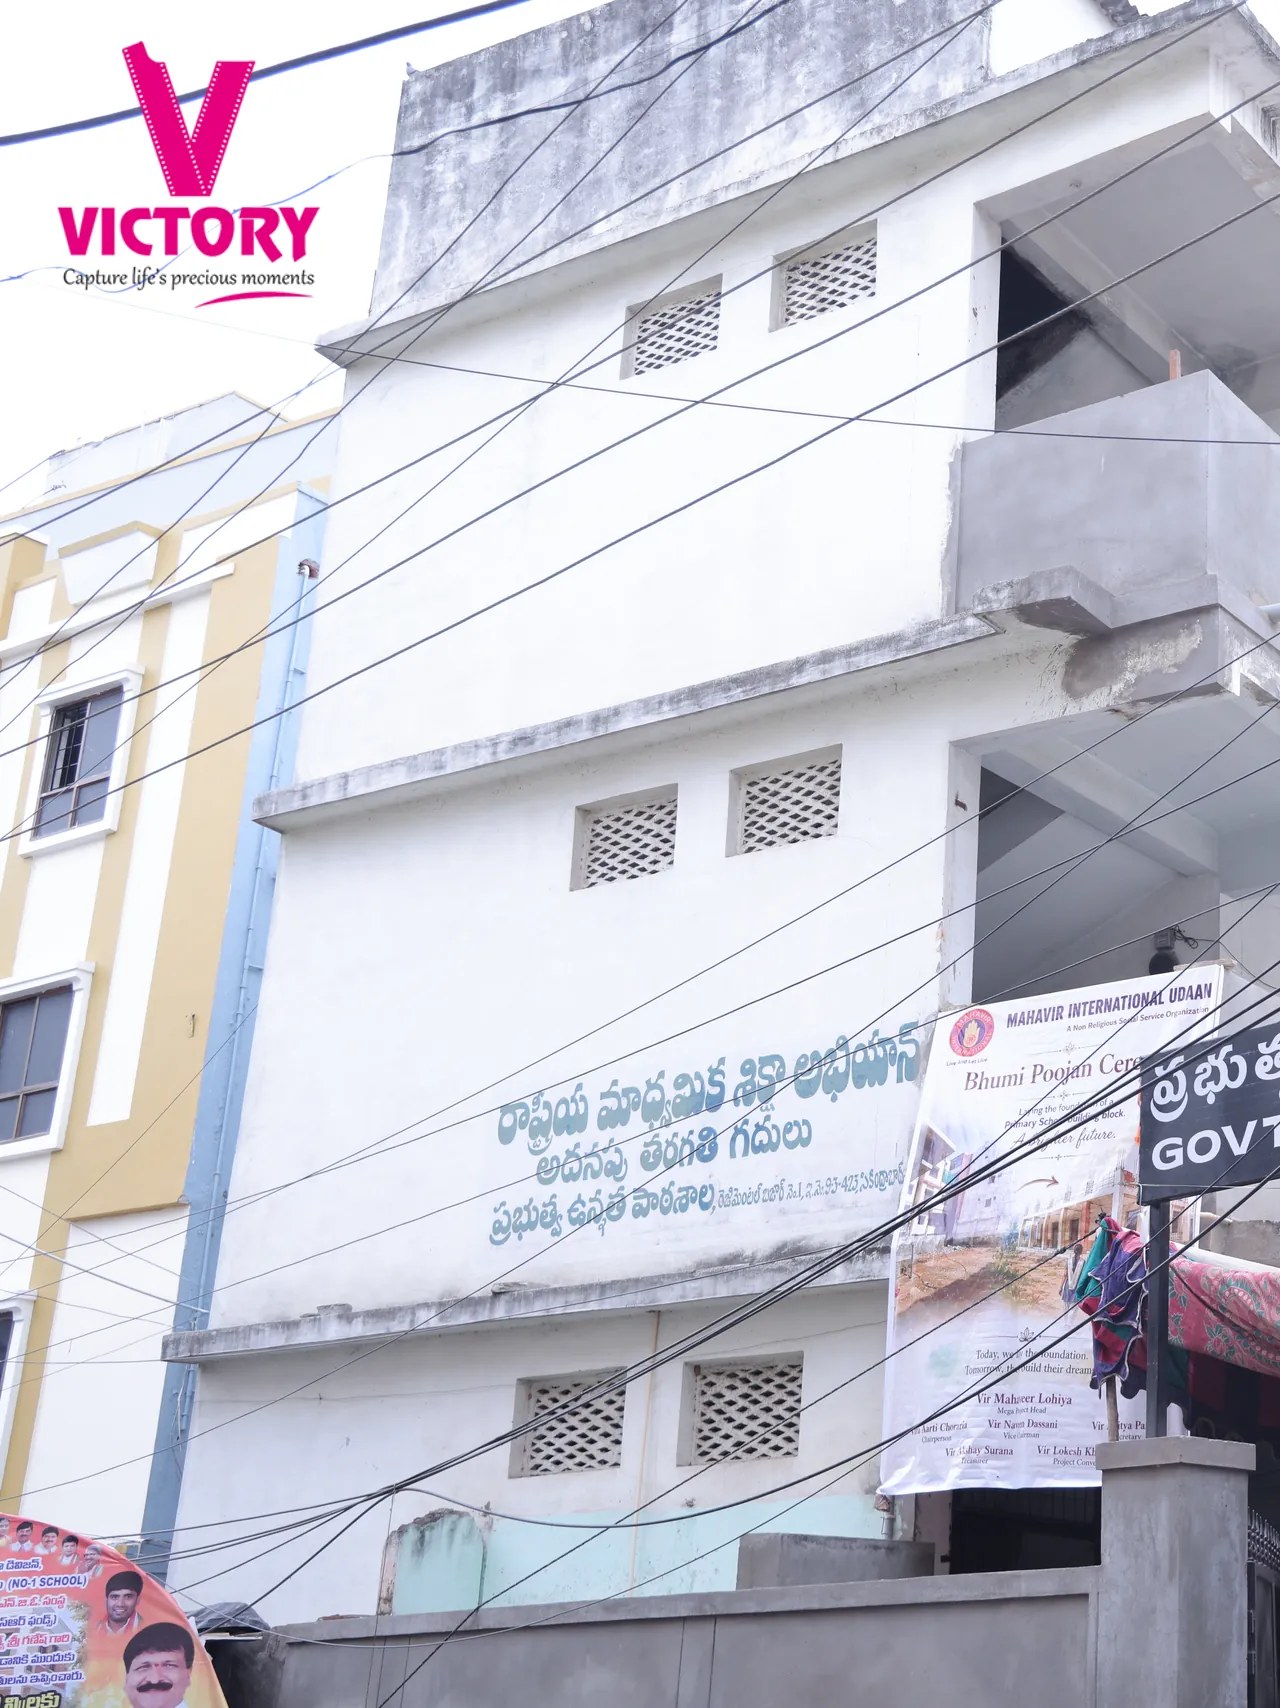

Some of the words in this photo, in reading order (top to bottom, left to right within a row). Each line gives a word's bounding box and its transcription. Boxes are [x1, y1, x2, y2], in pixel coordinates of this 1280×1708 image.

[1007, 1005, 1064, 1028] MAHAVIR
[1068, 989, 1165, 1019] INTERNATIONAL
[1169, 982, 1213, 1004] UDAAN
[1088, 1019, 1117, 1030] Religious
[1140, 1012, 1164, 1022] Service
[964, 1066, 1025, 1091] Bhumi
[1031, 1060, 1092, 1085] Poojan
[976, 1349, 1000, 1360] Today,
[1043, 1363, 1064, 1373] their
[976, 1393, 992, 1404] Vir
[1039, 1393, 1072, 1407] Lohiya
[988, 1419, 1001, 1429] Vir
[1027, 1419, 1058, 1429] Dassani
[1092, 1421, 1105, 1431] Vir
[984, 1445, 1014, 1456] Surana
[1037, 1445, 1051, 1455] Vir
[1053, 1446, 1082, 1456] Lokesh
[1053, 1458, 1075, 1466] Project
[8, 1577, 37, 1590] (NO-1
[40, 1575, 87, 1588] SCHOOL)
